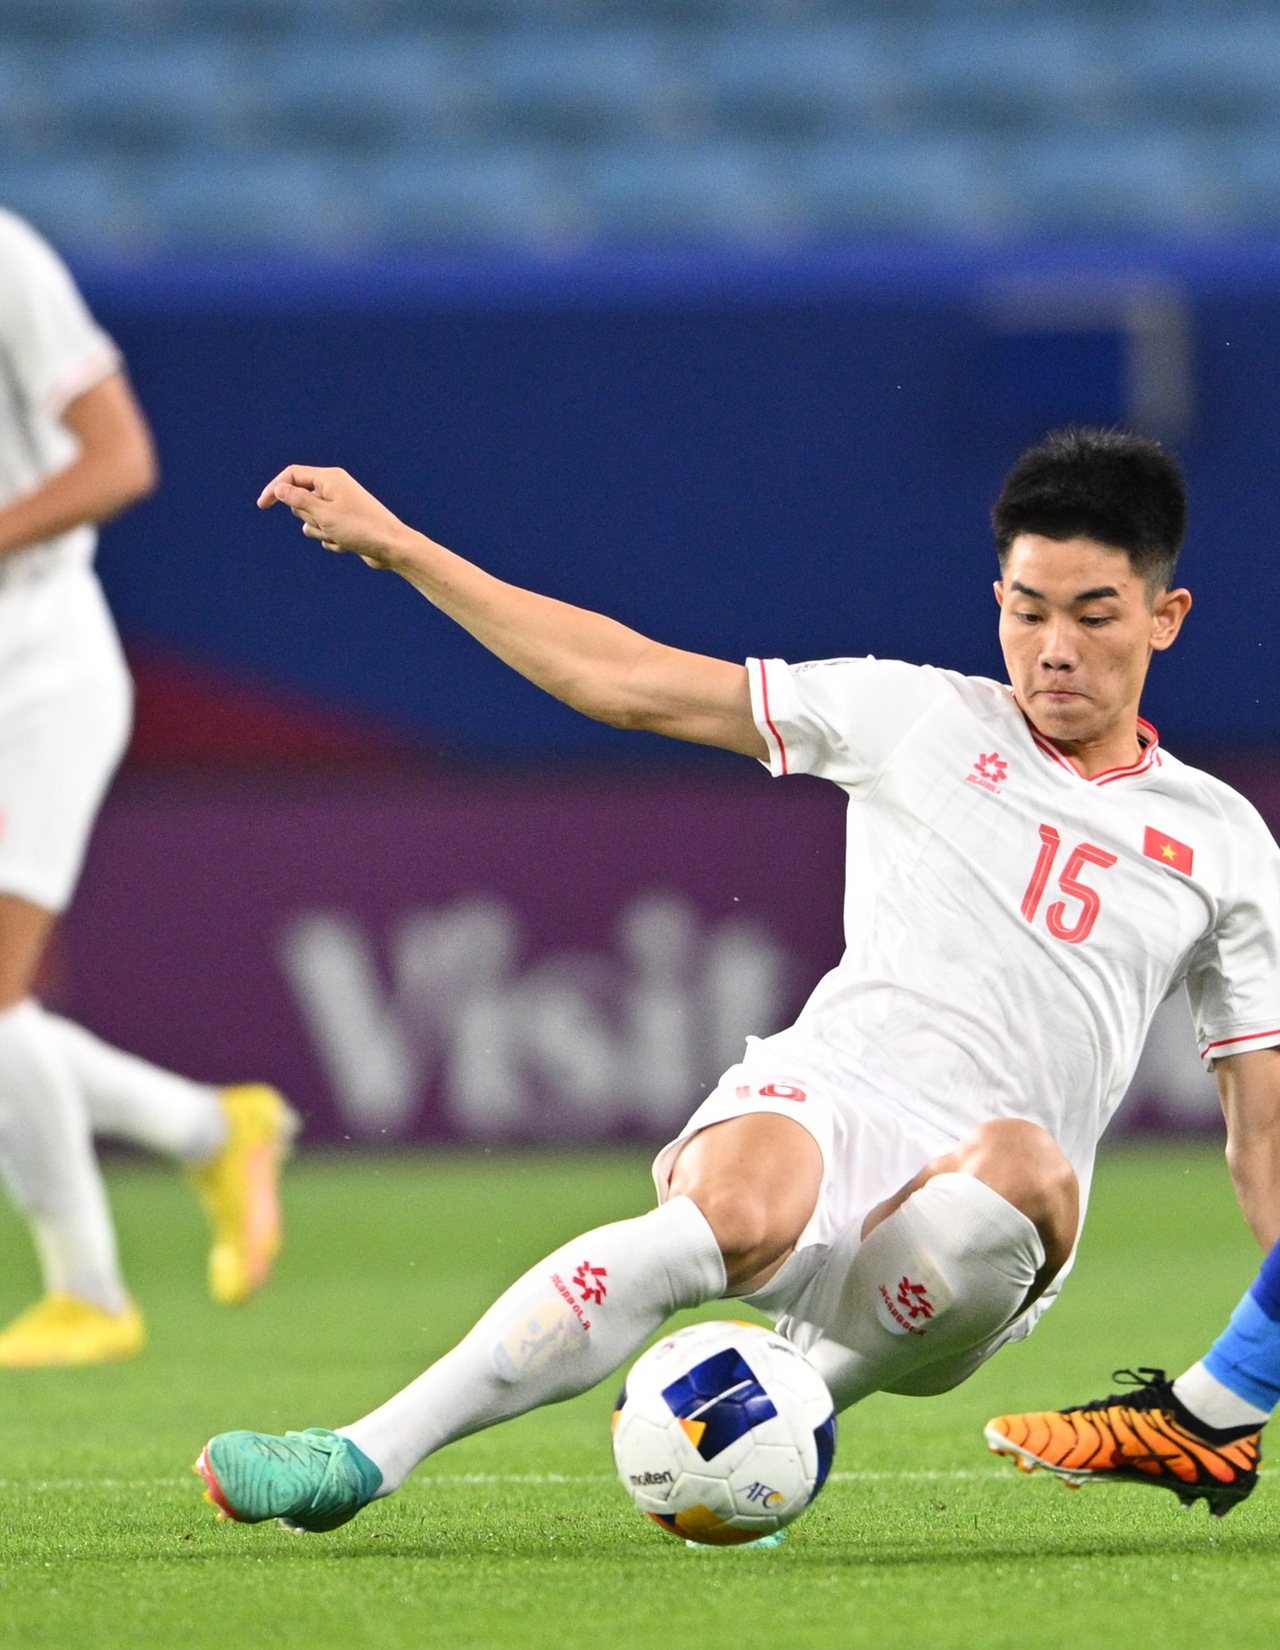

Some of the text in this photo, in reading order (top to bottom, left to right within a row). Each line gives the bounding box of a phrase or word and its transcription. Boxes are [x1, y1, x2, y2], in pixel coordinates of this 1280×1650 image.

[1020, 823, 1118, 944] 15
[629, 1470, 674, 1487] molten
[737, 1482, 782, 1509] AFC
